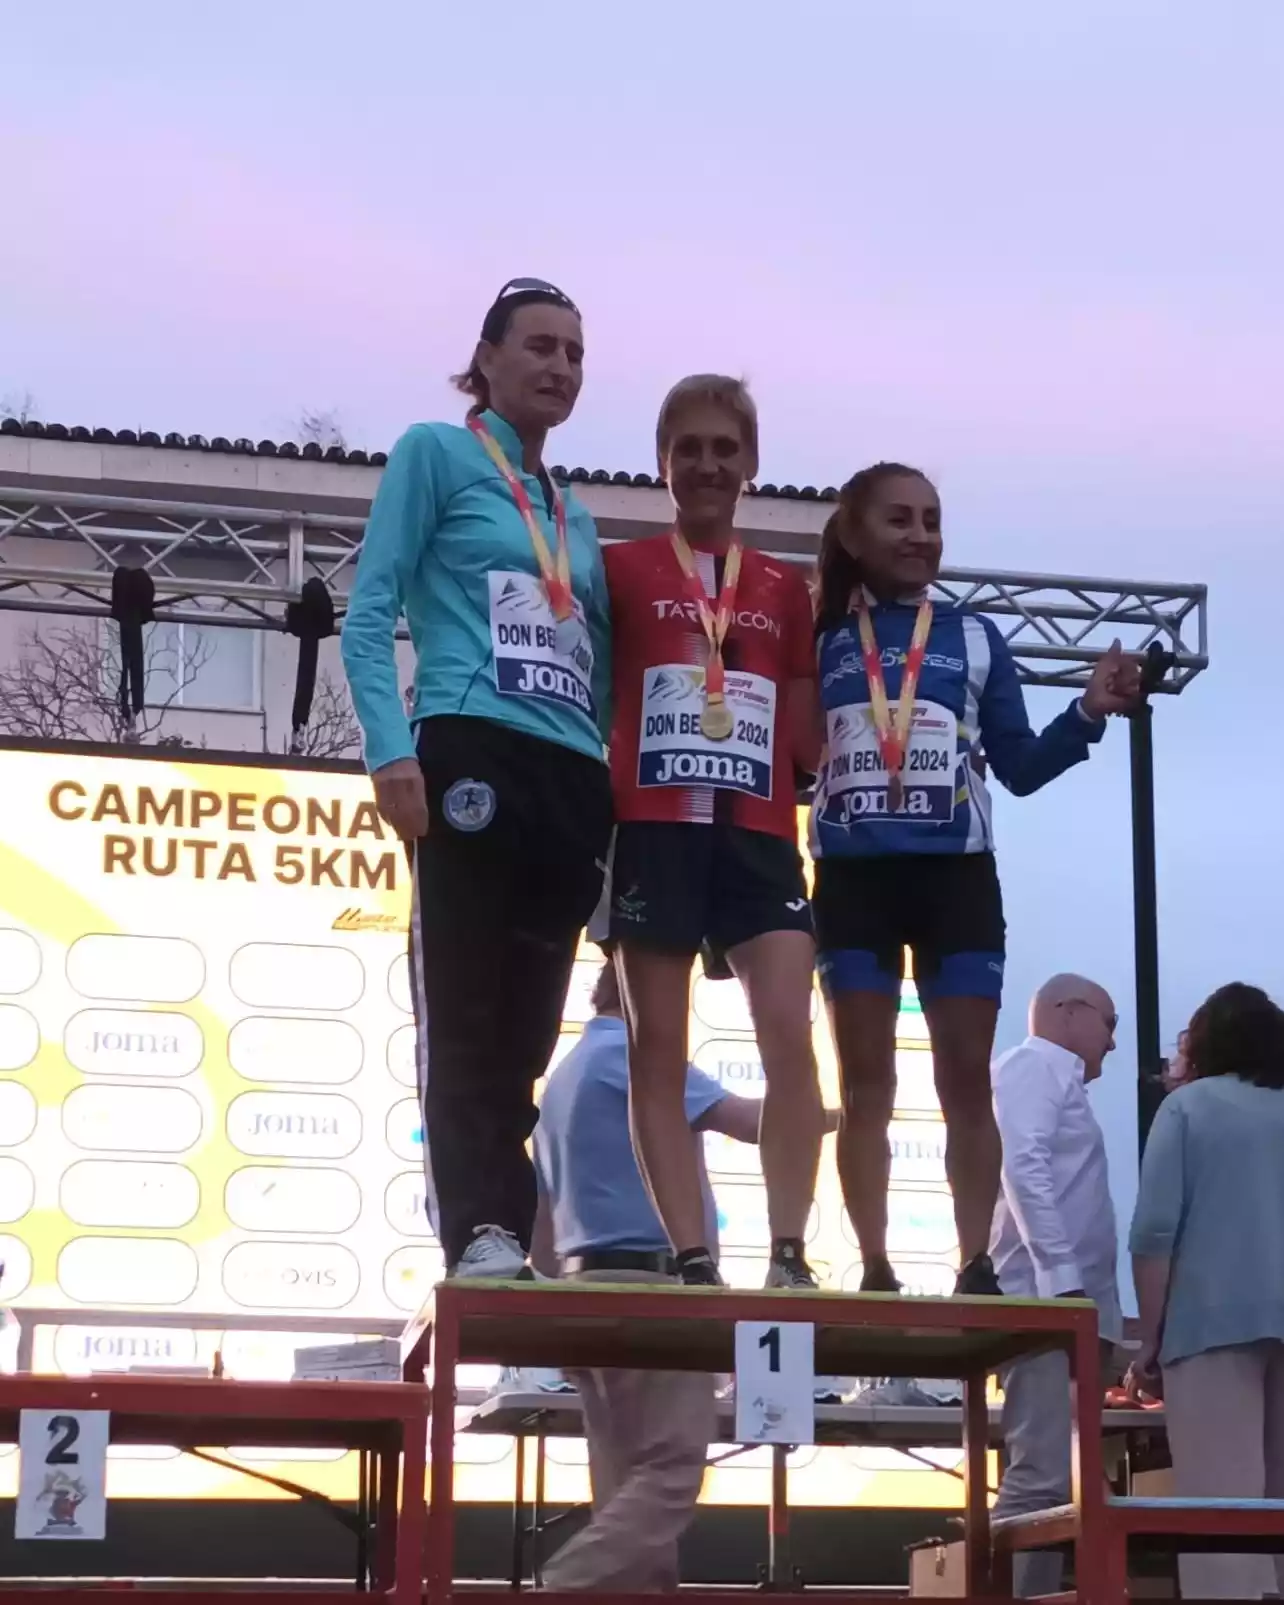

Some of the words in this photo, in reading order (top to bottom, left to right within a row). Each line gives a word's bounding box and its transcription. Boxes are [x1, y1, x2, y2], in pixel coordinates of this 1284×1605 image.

[498, 623, 531, 646] DON
[651, 599, 781, 640] TARCÓN
[646, 715, 675, 737] DON
[737, 719, 769, 749] 2024
[910, 749, 949, 771] 2024
[48, 780, 400, 841] CAMPEONA
[103, 834, 256, 882] RUTA
[274, 846, 396, 890] 5KM
[758, 1325, 782, 1373] 1
[45, 1414, 81, 1464] 2
